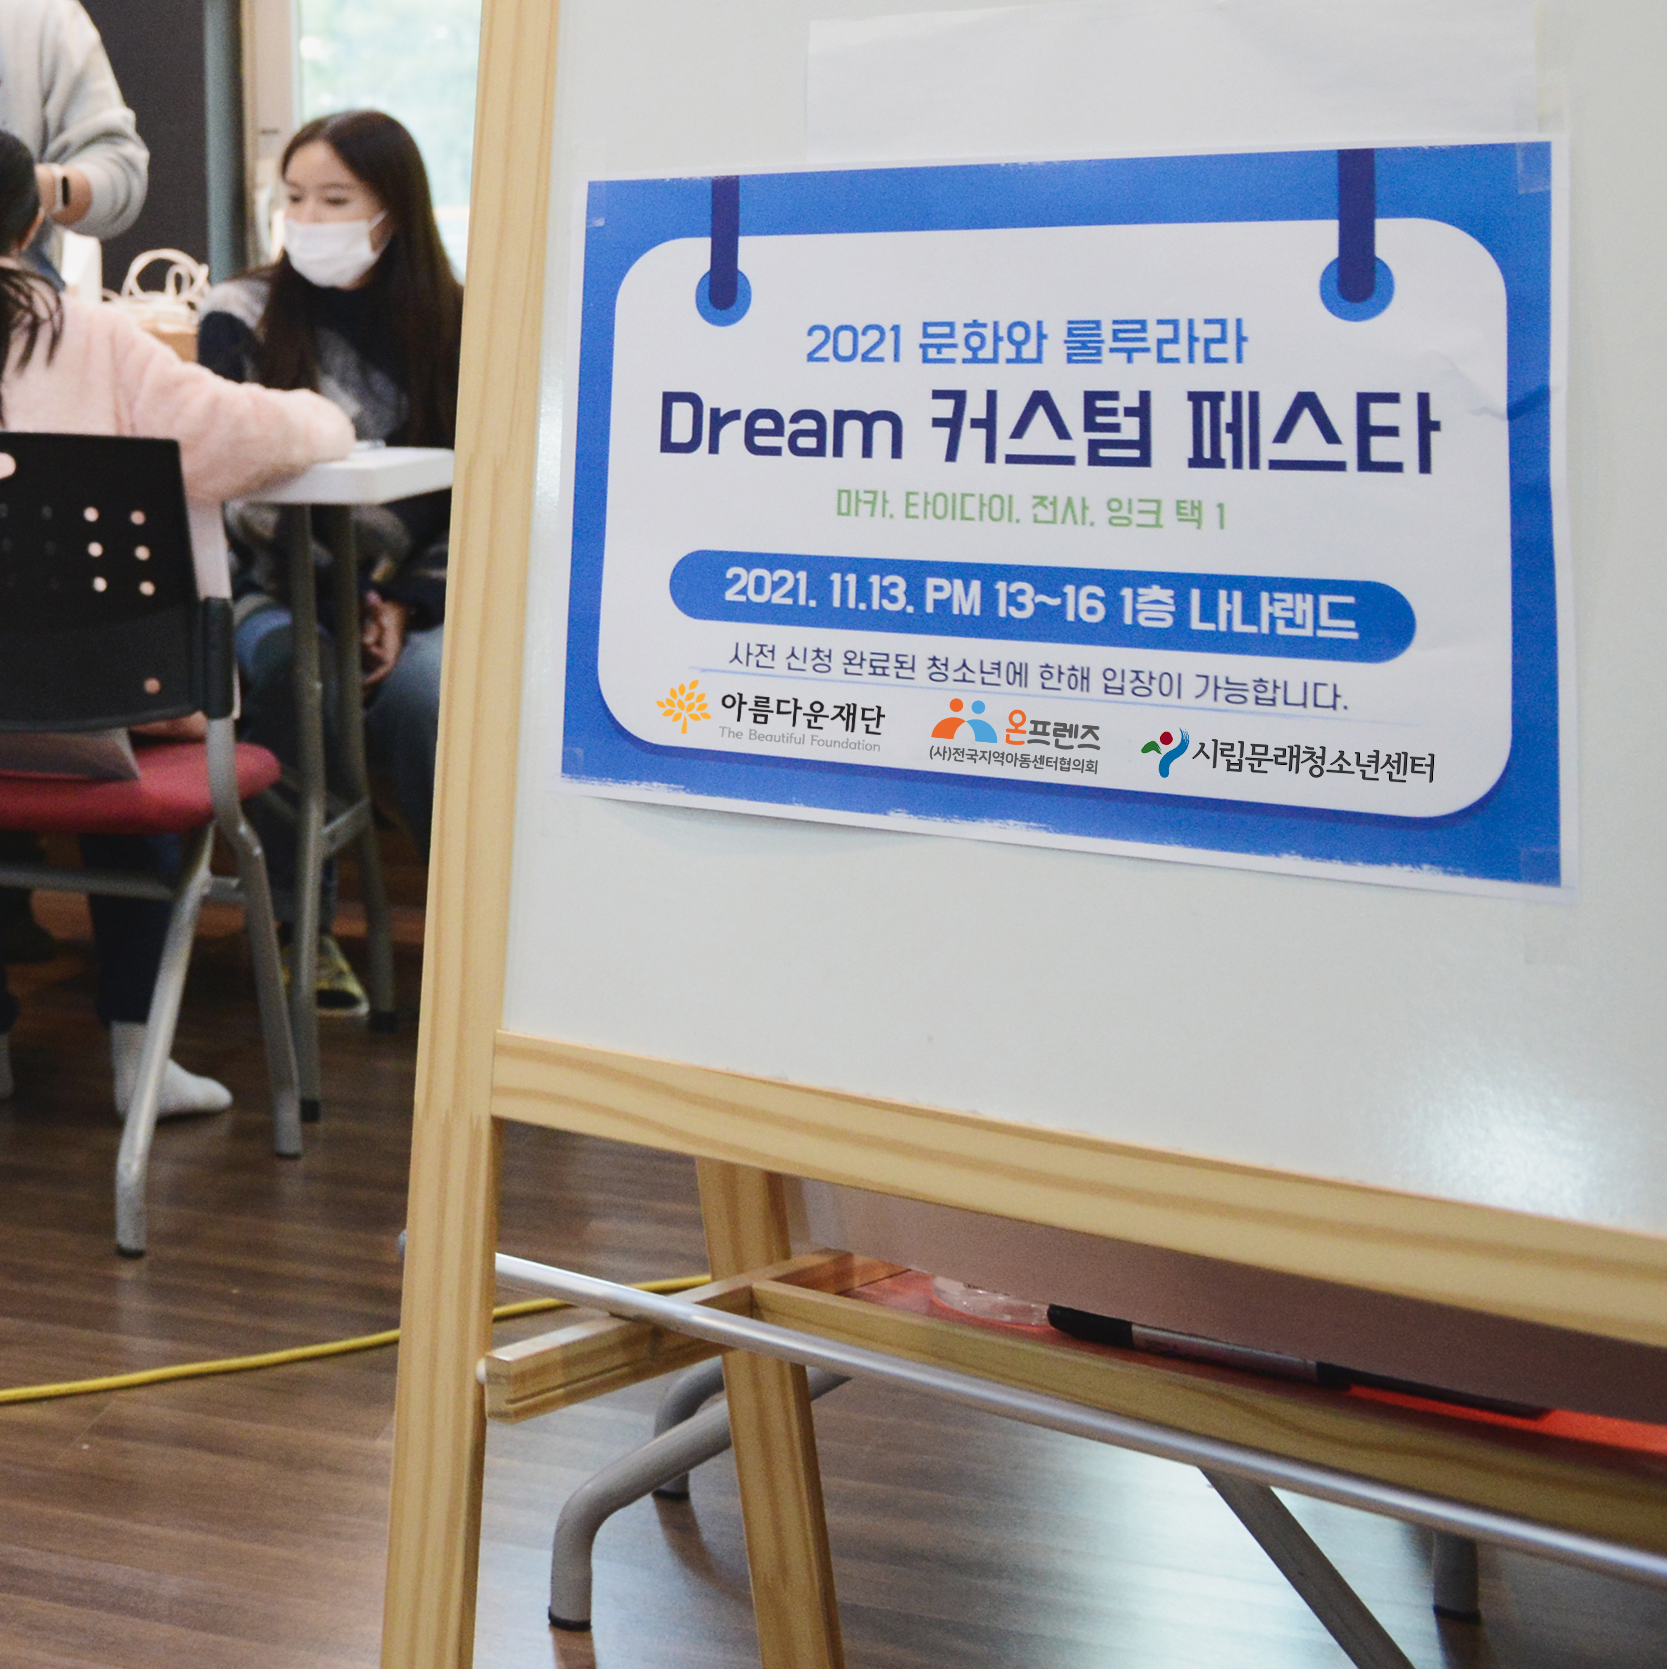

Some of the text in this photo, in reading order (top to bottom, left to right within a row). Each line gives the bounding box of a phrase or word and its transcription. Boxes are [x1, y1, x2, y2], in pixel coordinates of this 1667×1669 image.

[805, 317, 1249, 365] 2021 문화와 룰루라라
[658, 388, 1442, 475] Dream 커스텀 페스타
[1105, 496, 1165, 529] 잉크
[1174, 498, 1203, 531] 택
[1216, 501, 1226, 531] 1
[724, 566, 1361, 640] 2021. 11.13. PM 13~16 1층 나나랜드
[728, 641, 1350, 712] 사전 신청 완료된 청소년에 한해 입장이 가능합니다.
[720, 691, 886, 736] 아름다운재단
[1005, 708, 1102, 751] 온프렌즈
[718, 725, 882, 753] The Beautiful Foundation
[929, 744, 1100, 775] (사)전국지역아동센터협의회
[1191, 737, 1437, 784] 시립문래청소년센터
